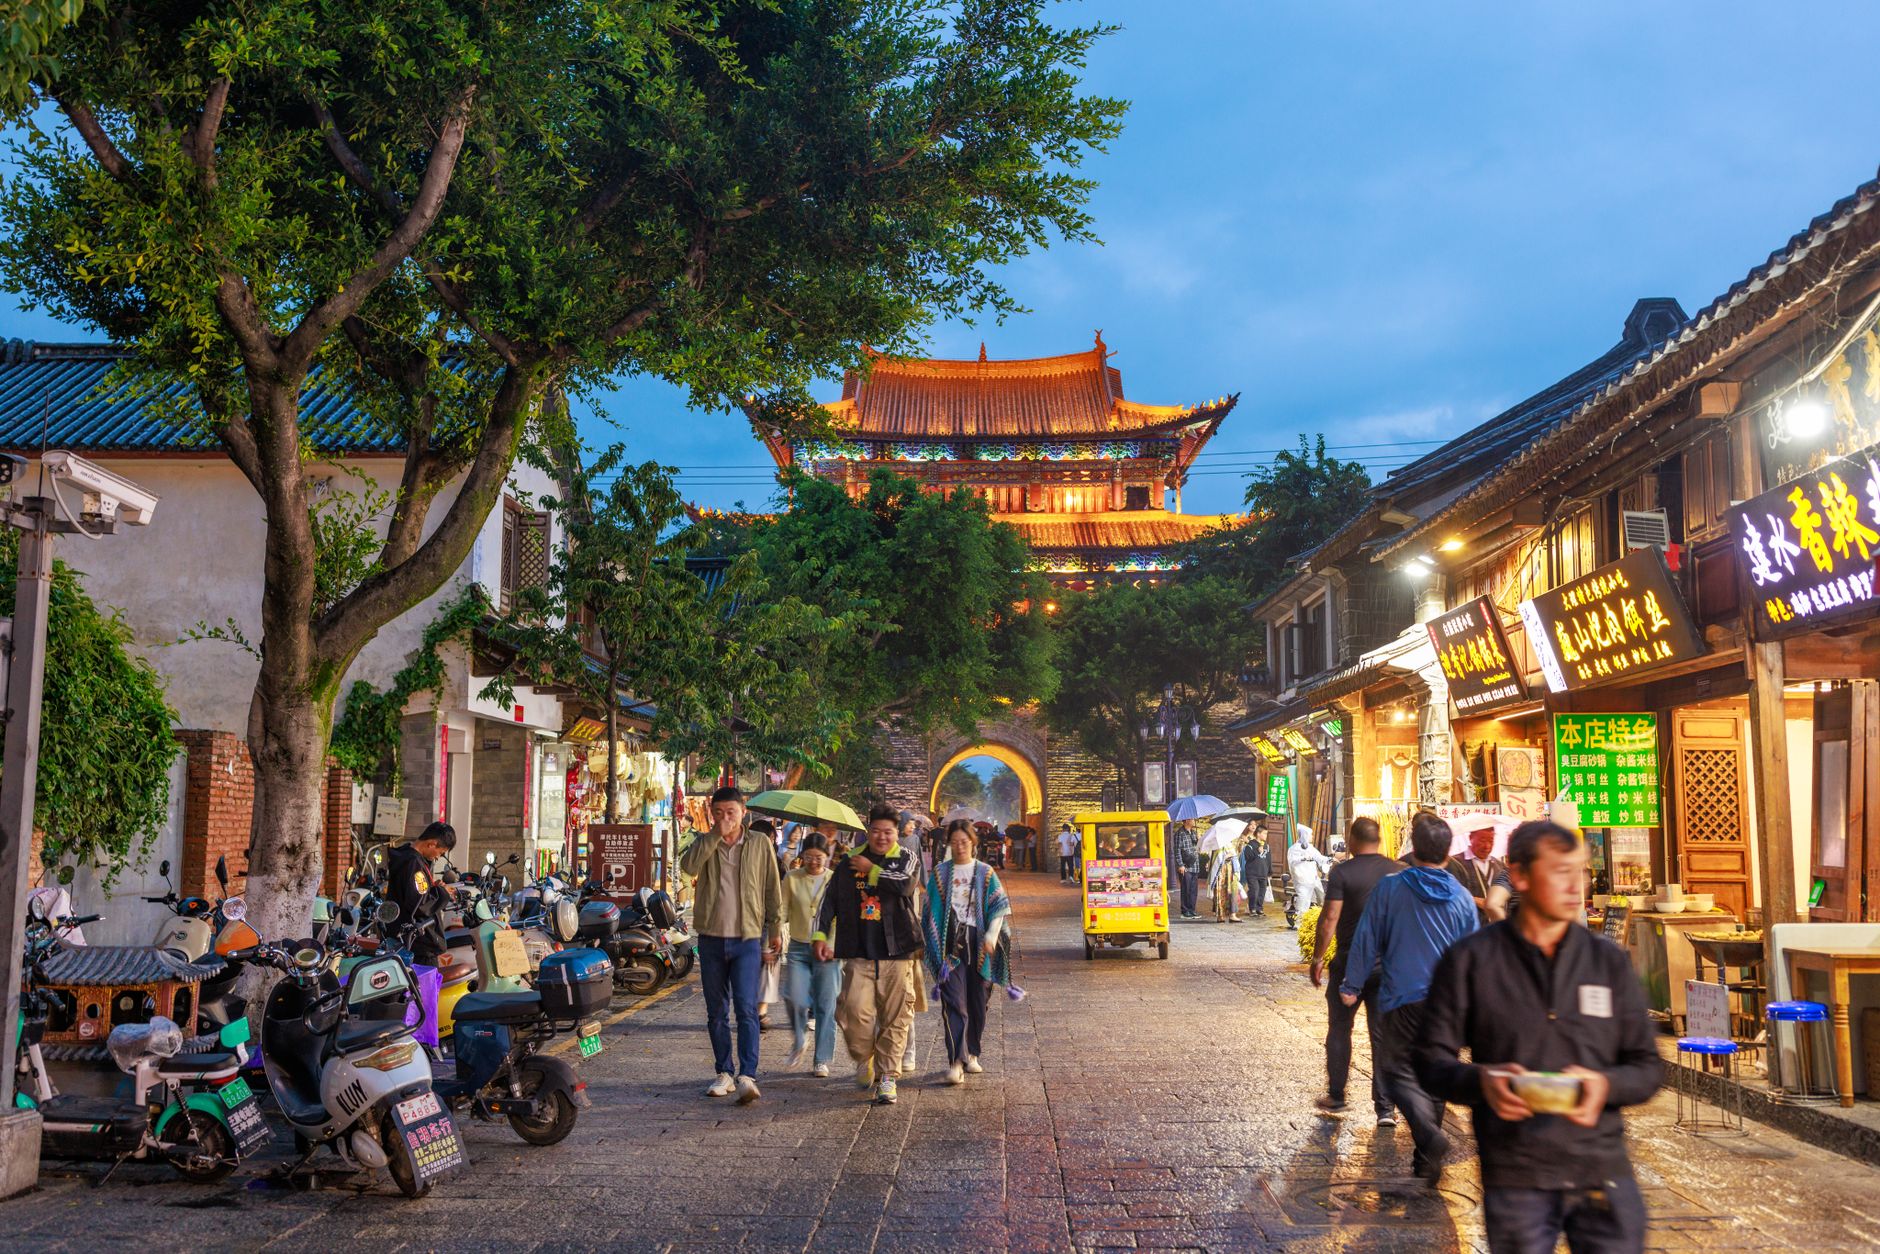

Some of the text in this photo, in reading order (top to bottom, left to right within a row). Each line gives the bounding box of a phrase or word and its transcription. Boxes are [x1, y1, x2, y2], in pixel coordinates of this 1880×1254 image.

[1560, 718, 1655, 750] 本店特色
[1561, 754, 1657, 767] 臭豆腐砂锅 杂酱米线
[1617, 773, 1658, 786] 杂酱饵丝
[1618, 792, 1658, 805] 炒米线
[1619, 811, 1659, 823] 炒饵丝
[610, 864, 627, 884] P
